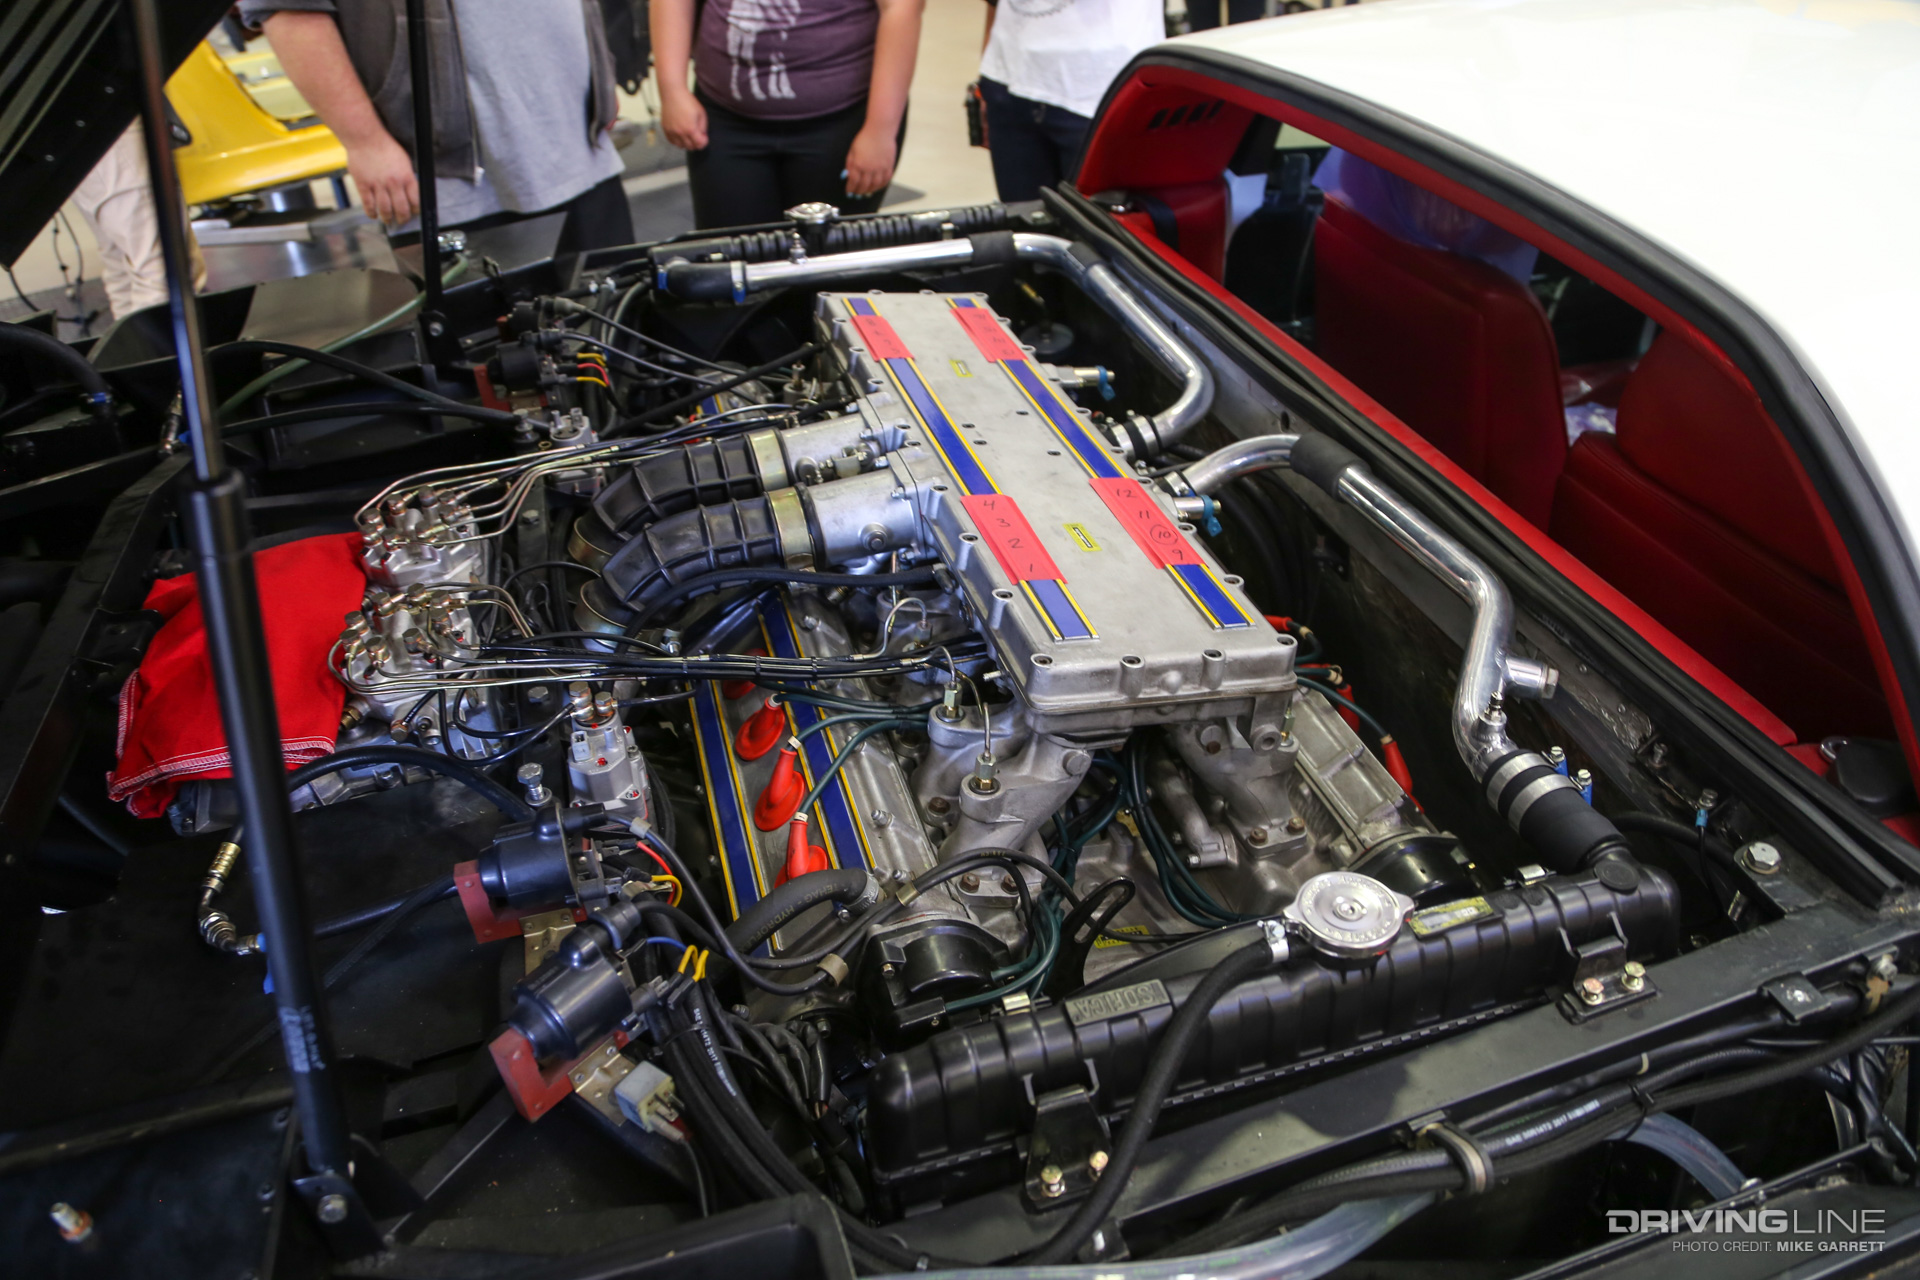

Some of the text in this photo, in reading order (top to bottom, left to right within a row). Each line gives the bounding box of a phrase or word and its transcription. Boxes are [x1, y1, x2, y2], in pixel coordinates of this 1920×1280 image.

[1116, 488, 1137, 498] 12
[983, 500, 995, 510] 4
[1139, 510, 1150, 519] 11
[996, 518, 1011, 527] 3
[1158, 530, 1171, 539] 10
[1008, 538, 1023, 548] 2
[1172, 549, 1183, 560] 9
[1073, 985, 1154, 1018] SOFICA
